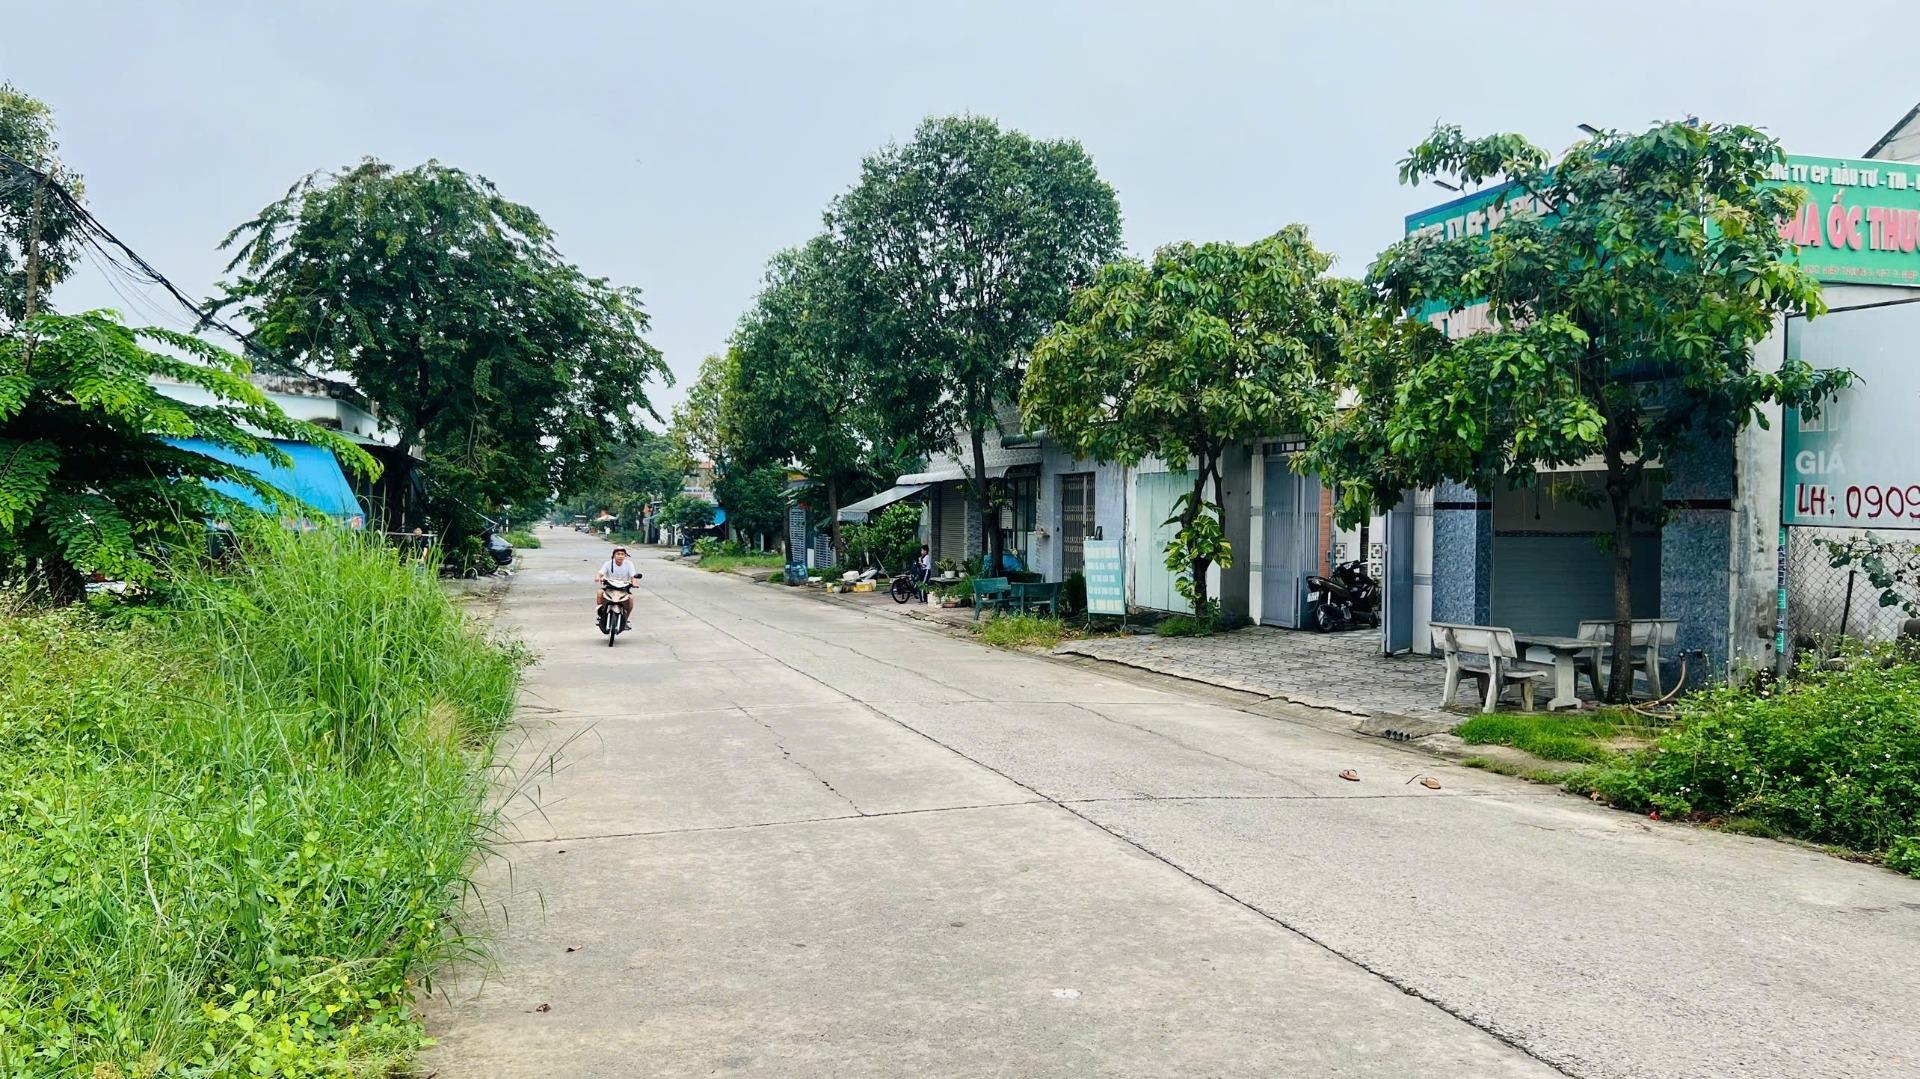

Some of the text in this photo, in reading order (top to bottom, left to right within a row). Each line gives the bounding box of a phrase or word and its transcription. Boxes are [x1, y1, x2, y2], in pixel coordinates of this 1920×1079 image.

[1790, 164, 1809, 182] TY
[1810, 165, 1829, 184] CP
[1827, 188, 1862, 250] ỐC
[1867, 207, 1920, 253] THƯ
[1795, 443, 1847, 475] GIÁ
